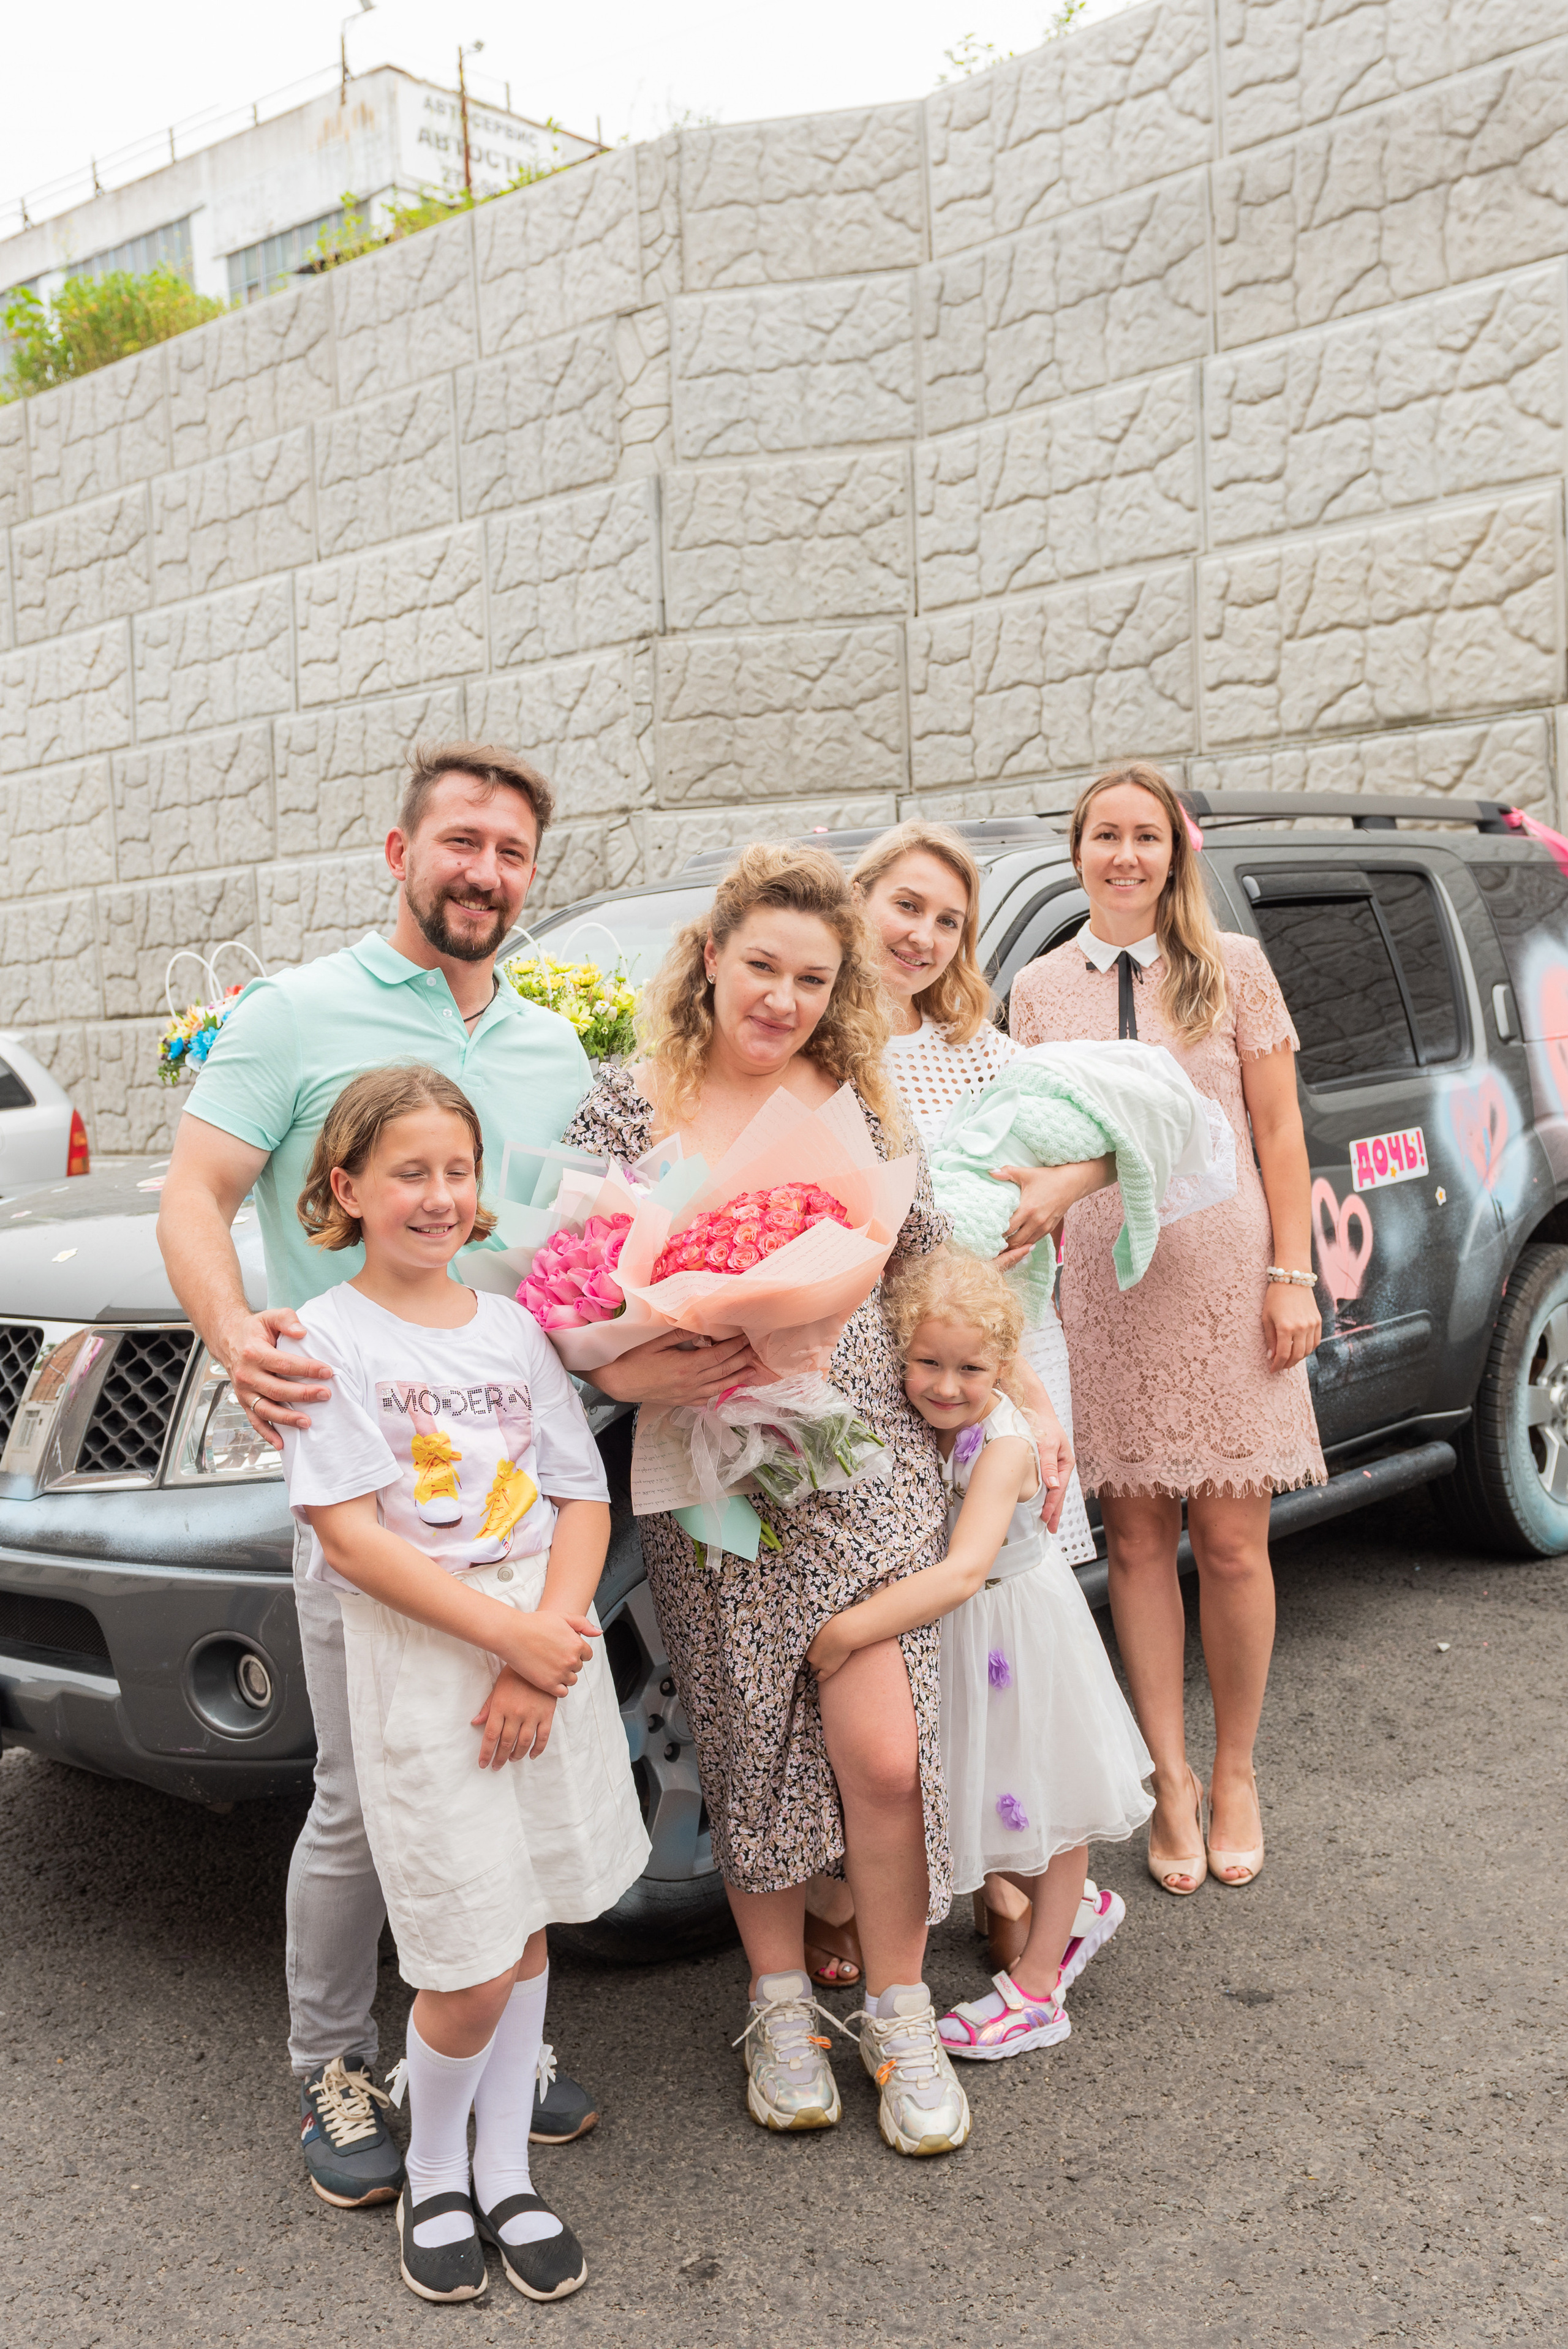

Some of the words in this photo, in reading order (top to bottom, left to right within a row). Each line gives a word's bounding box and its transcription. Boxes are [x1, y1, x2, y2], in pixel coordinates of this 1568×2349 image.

[423, 94, 539, 148] АВТСЕРВИС
[1355, 1131, 1425, 1188] ДОЧЬ!
[381, 1385, 532, 1416] MODERN
